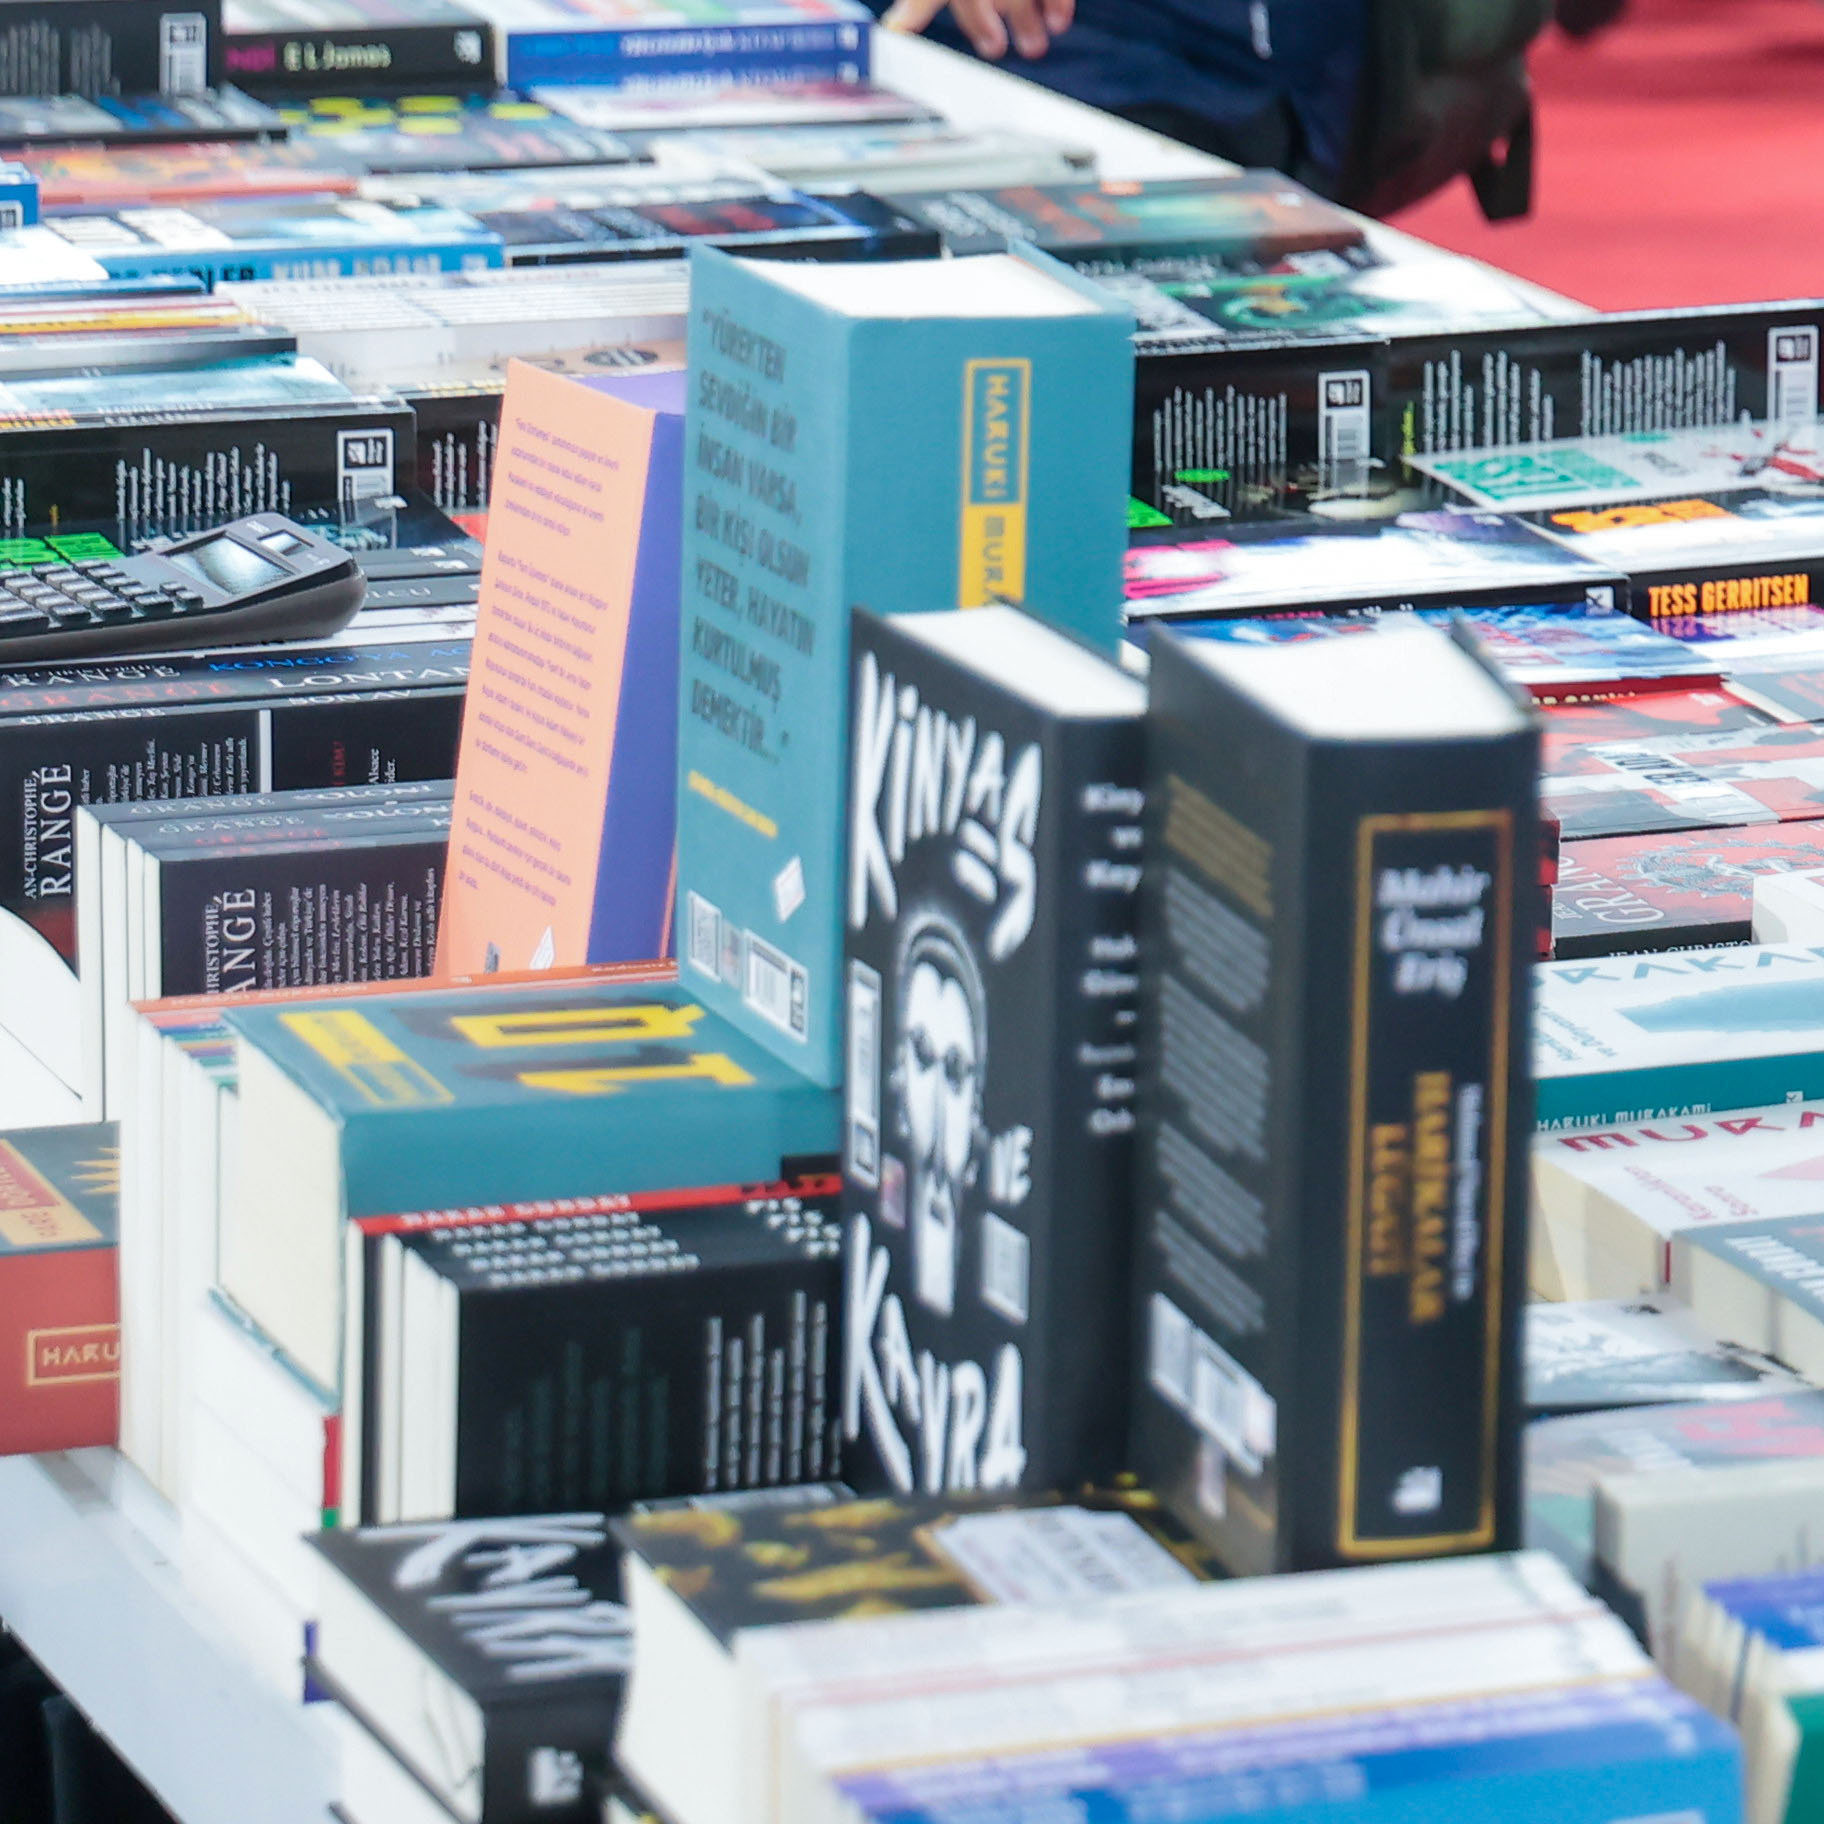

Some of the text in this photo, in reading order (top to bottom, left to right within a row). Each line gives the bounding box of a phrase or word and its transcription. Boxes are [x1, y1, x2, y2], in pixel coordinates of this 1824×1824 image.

[1649, 582, 1697, 618] TESS
[1701, 573, 1810, 612] GERRITSEN
[843, 1212, 1028, 1495] KAYRA
